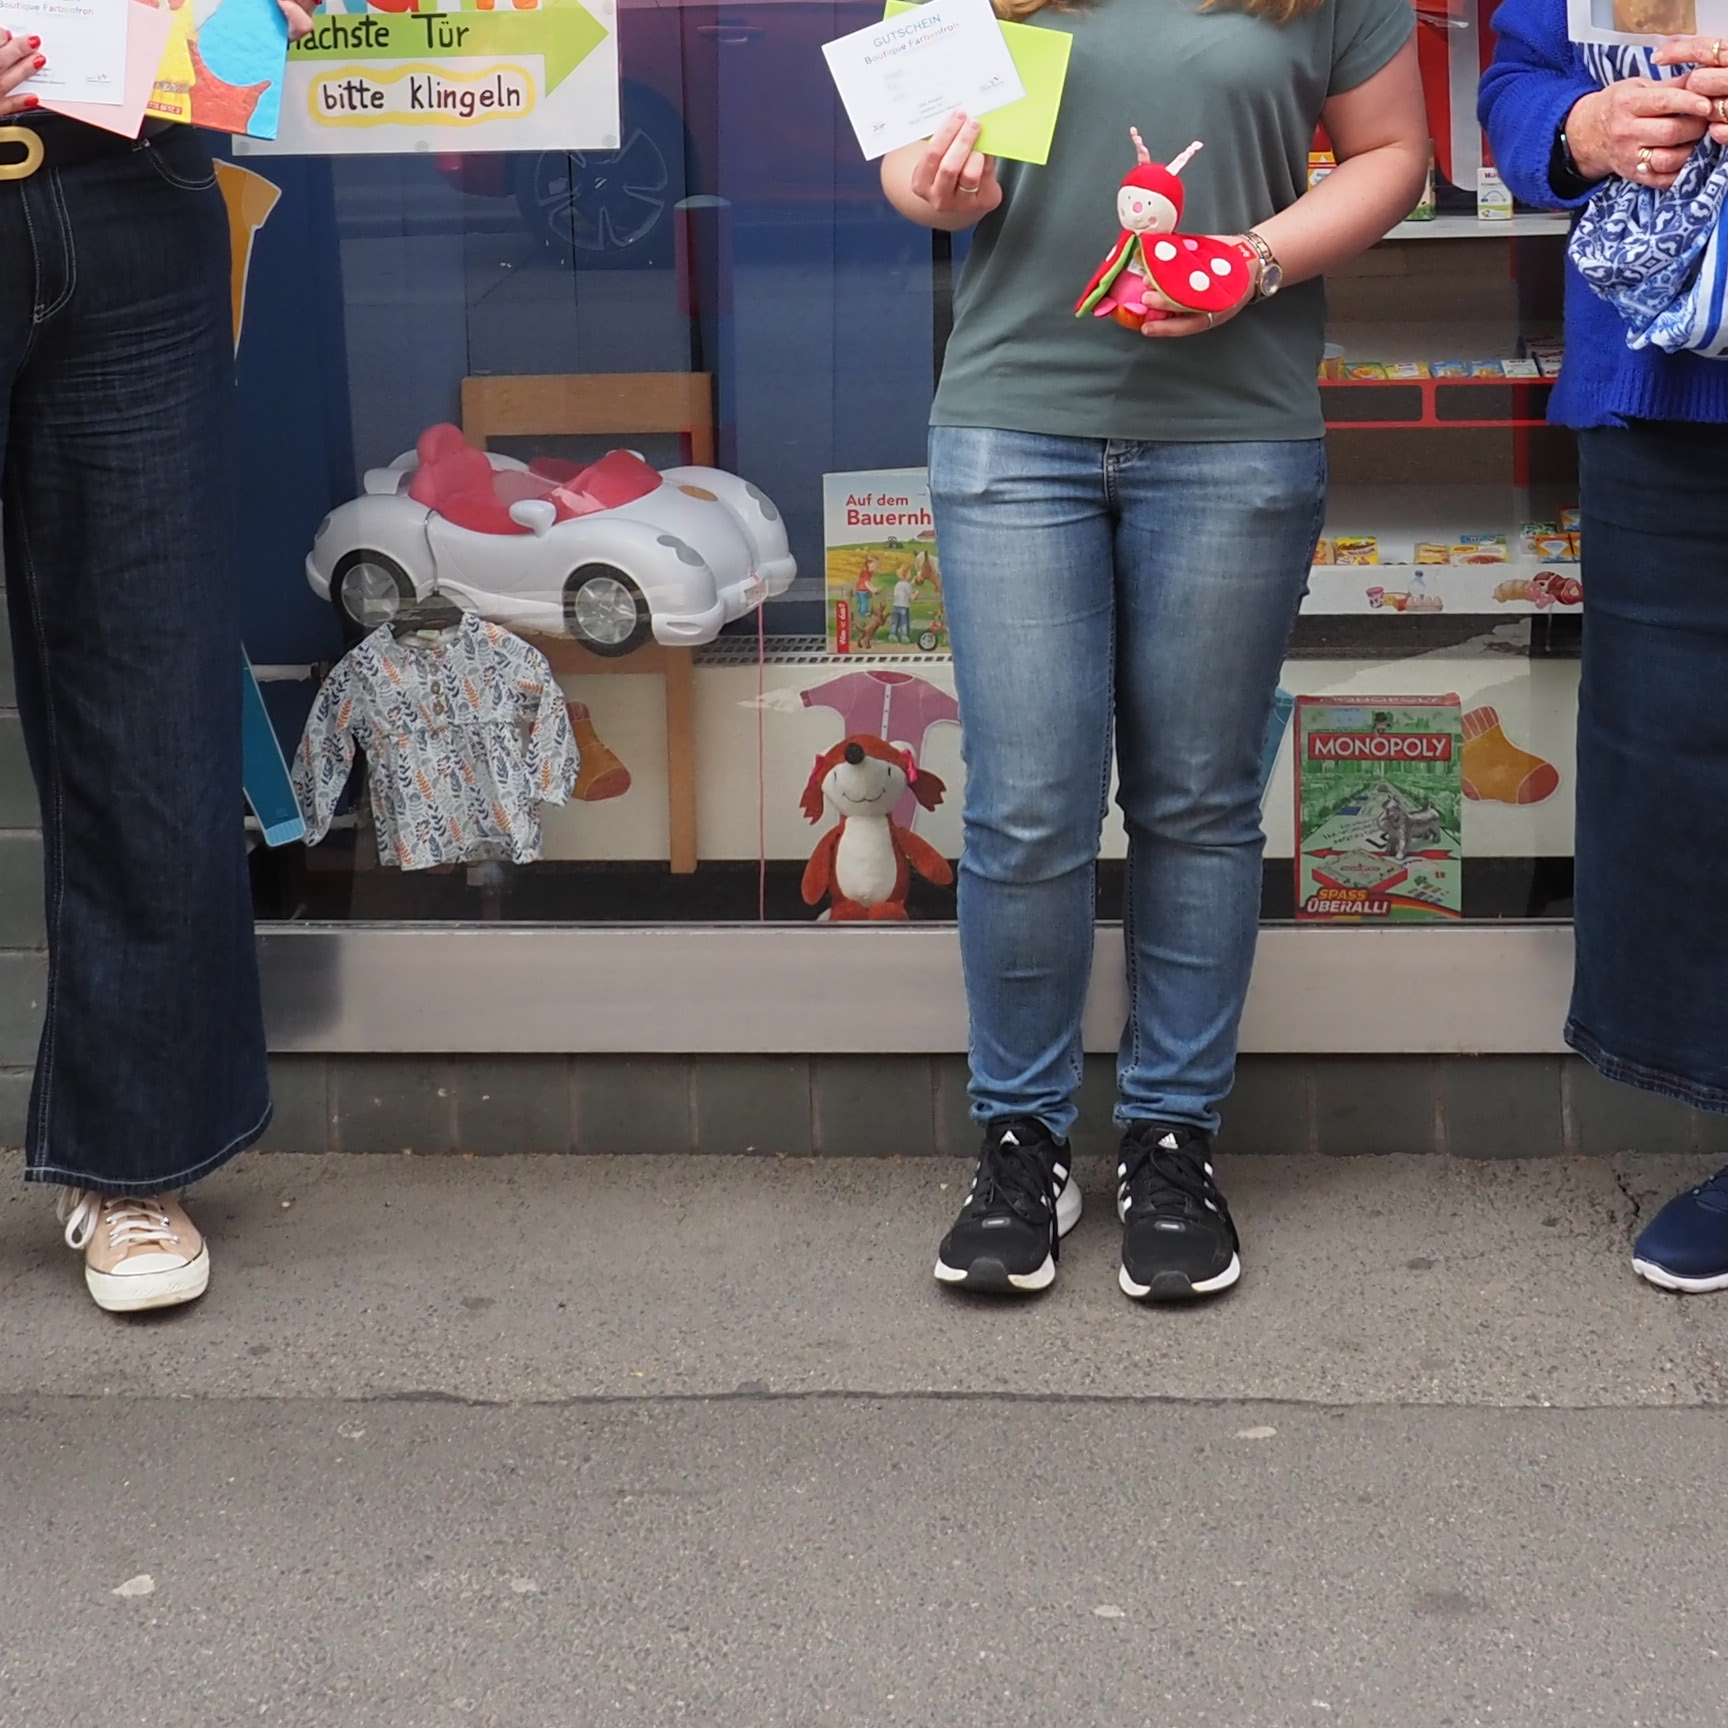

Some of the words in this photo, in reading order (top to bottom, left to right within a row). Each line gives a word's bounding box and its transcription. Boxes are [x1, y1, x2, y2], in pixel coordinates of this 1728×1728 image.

[411, 13, 470, 49] Tür
[873, 14, 941, 47] GUTSCHEIN
[323, 80, 384, 111] bitte
[410, 75, 520, 118] klingeln
[846, 493, 873, 506] Auf
[877, 493, 908, 506] dem
[847, 508, 932, 526] Bauernh
[1314, 737, 1446, 758] MONOPOLY
[1318, 889, 1368, 901] SPASS
